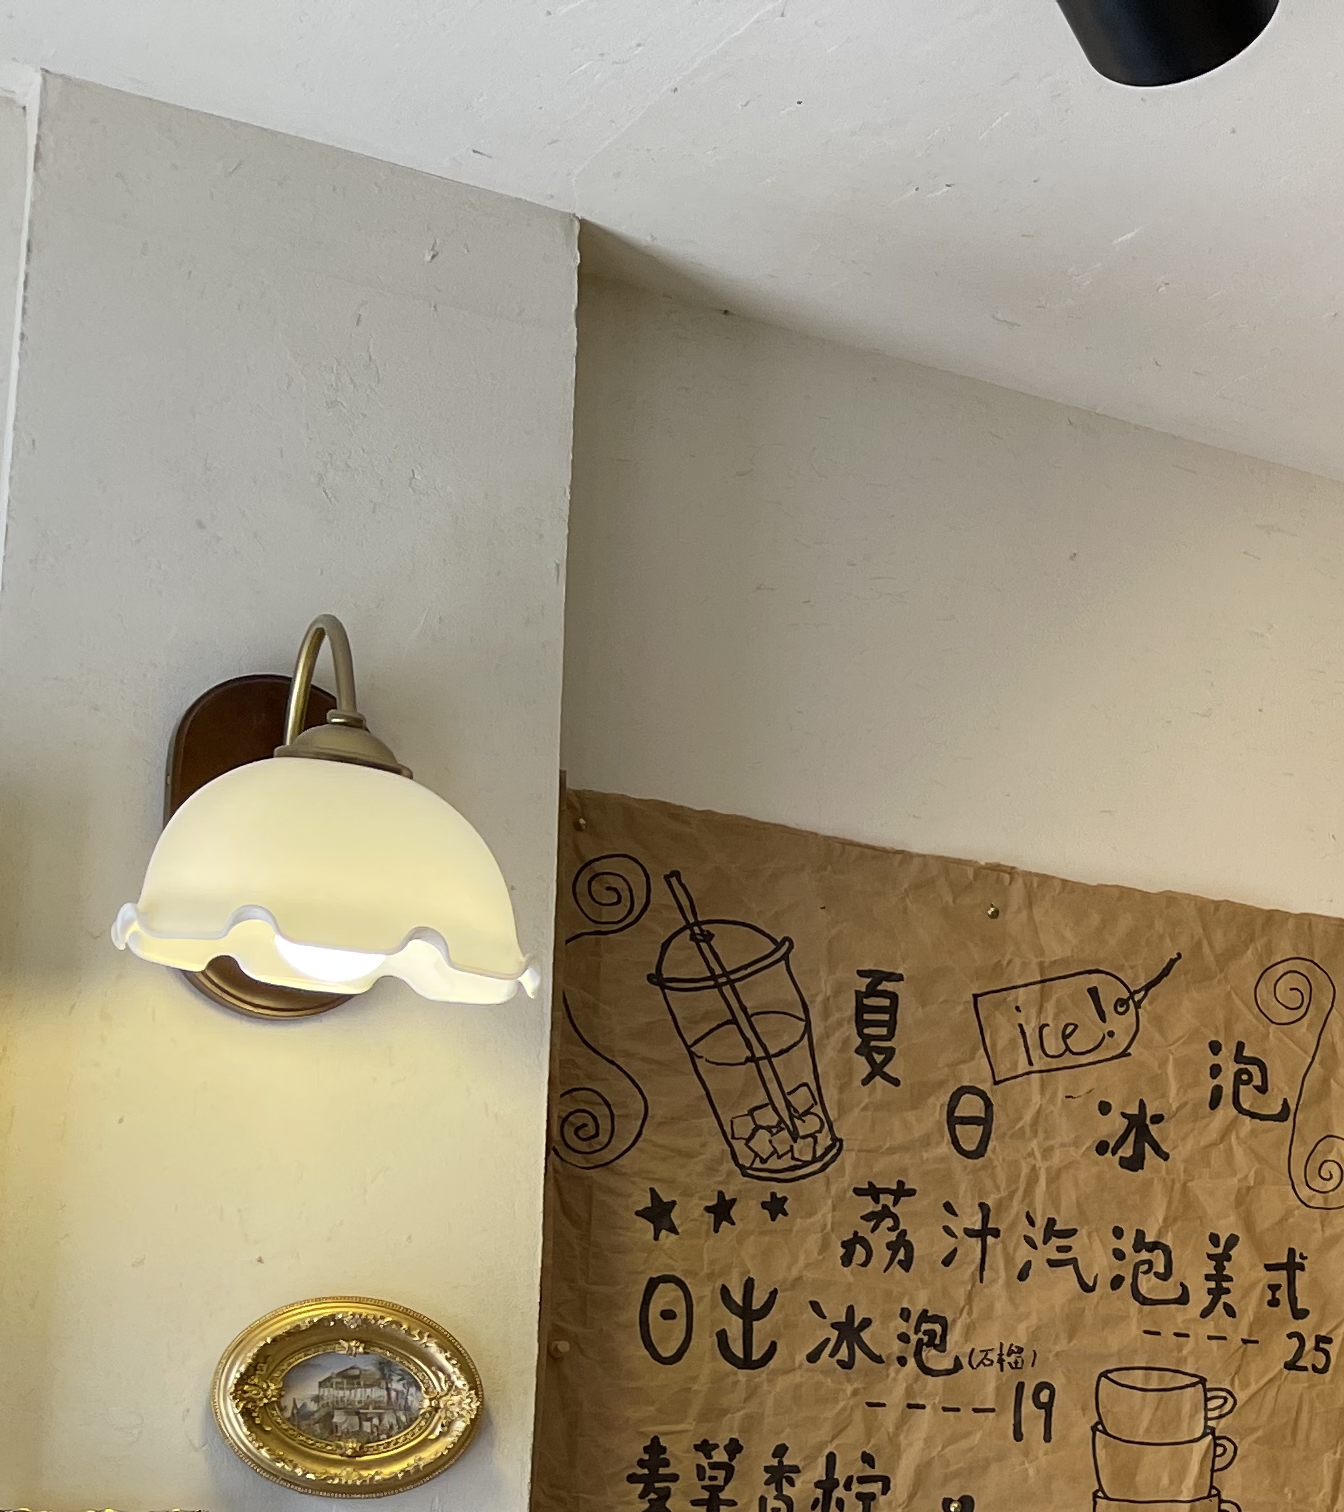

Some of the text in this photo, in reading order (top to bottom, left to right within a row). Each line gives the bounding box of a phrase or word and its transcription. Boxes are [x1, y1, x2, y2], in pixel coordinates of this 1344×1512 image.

[1016, 985, 1118, 1067] ice!
[1284, 1332, 1333, 1374] 25
[1010, 1381, 1057, 1443] 19
